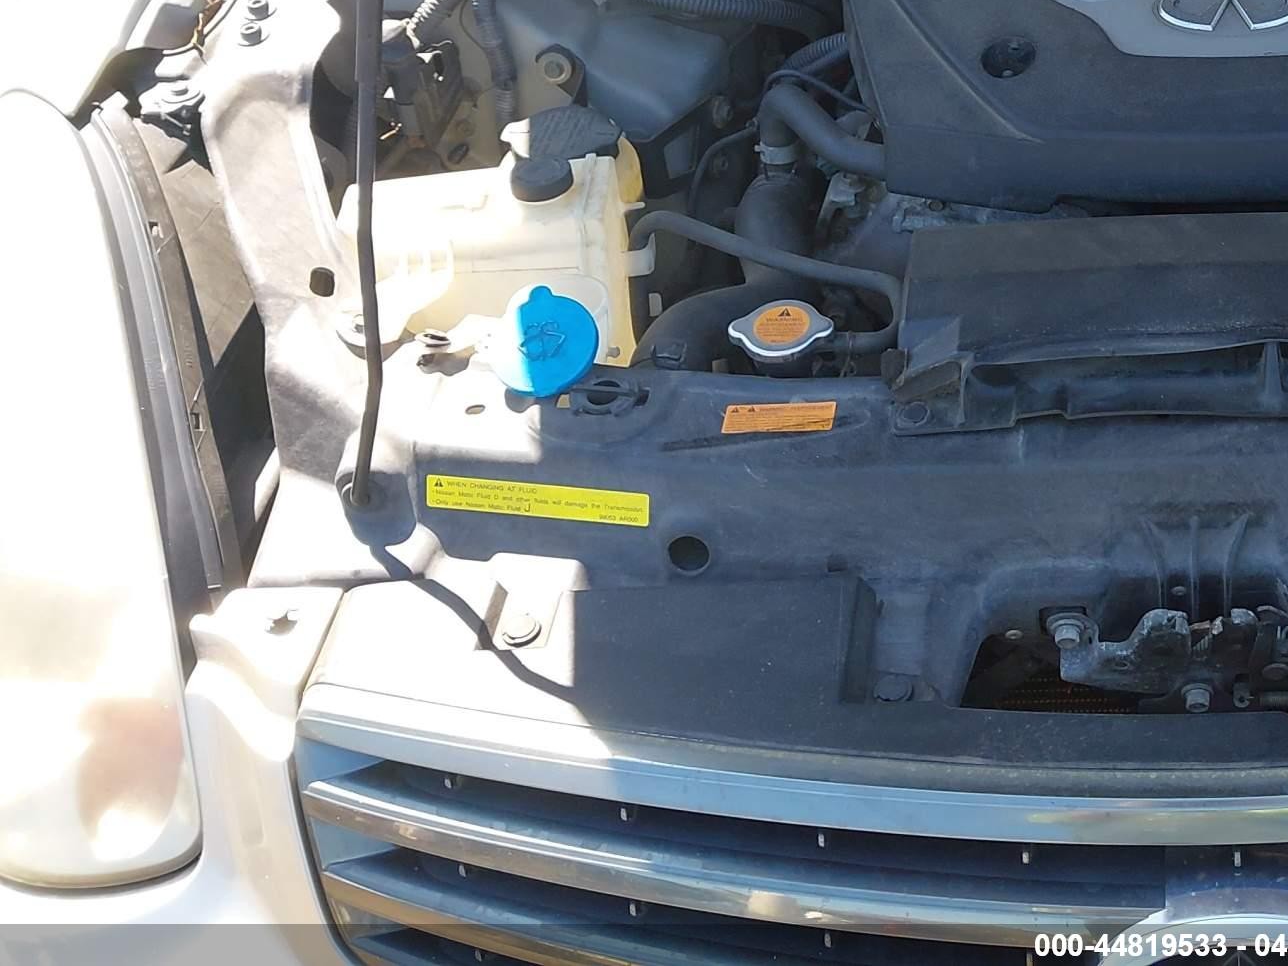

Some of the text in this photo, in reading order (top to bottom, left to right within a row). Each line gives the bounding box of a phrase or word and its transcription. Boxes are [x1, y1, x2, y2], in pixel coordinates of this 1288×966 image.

[447, 480, 467, 489] WHEN
[470, 482, 504, 492] CHANGING
[524, 503, 531, 513] J
